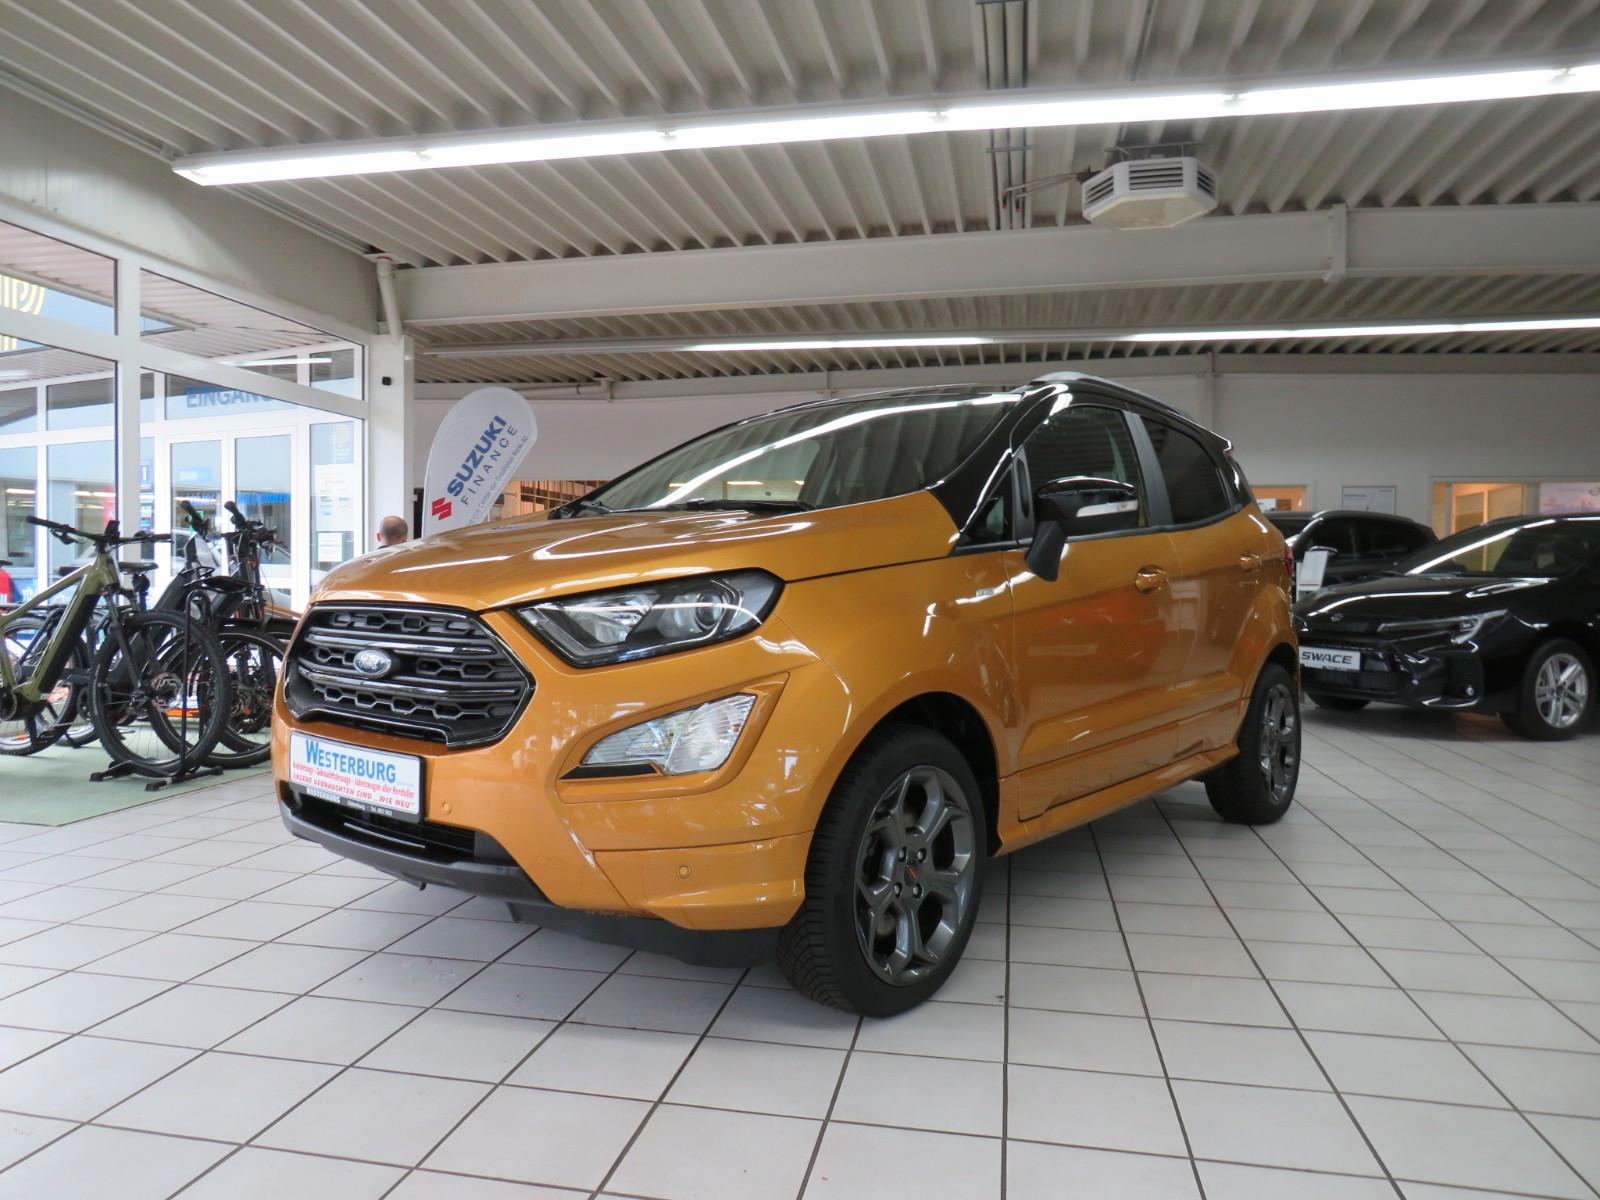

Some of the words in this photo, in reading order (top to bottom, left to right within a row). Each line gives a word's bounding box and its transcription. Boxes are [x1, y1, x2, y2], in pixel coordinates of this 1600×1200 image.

[186, 386, 273, 408] EINGAN
[447, 415, 508, 497] SUZUKI
[460, 425, 518, 505] FINANCE
[1301, 651, 1353, 665] SWACE
